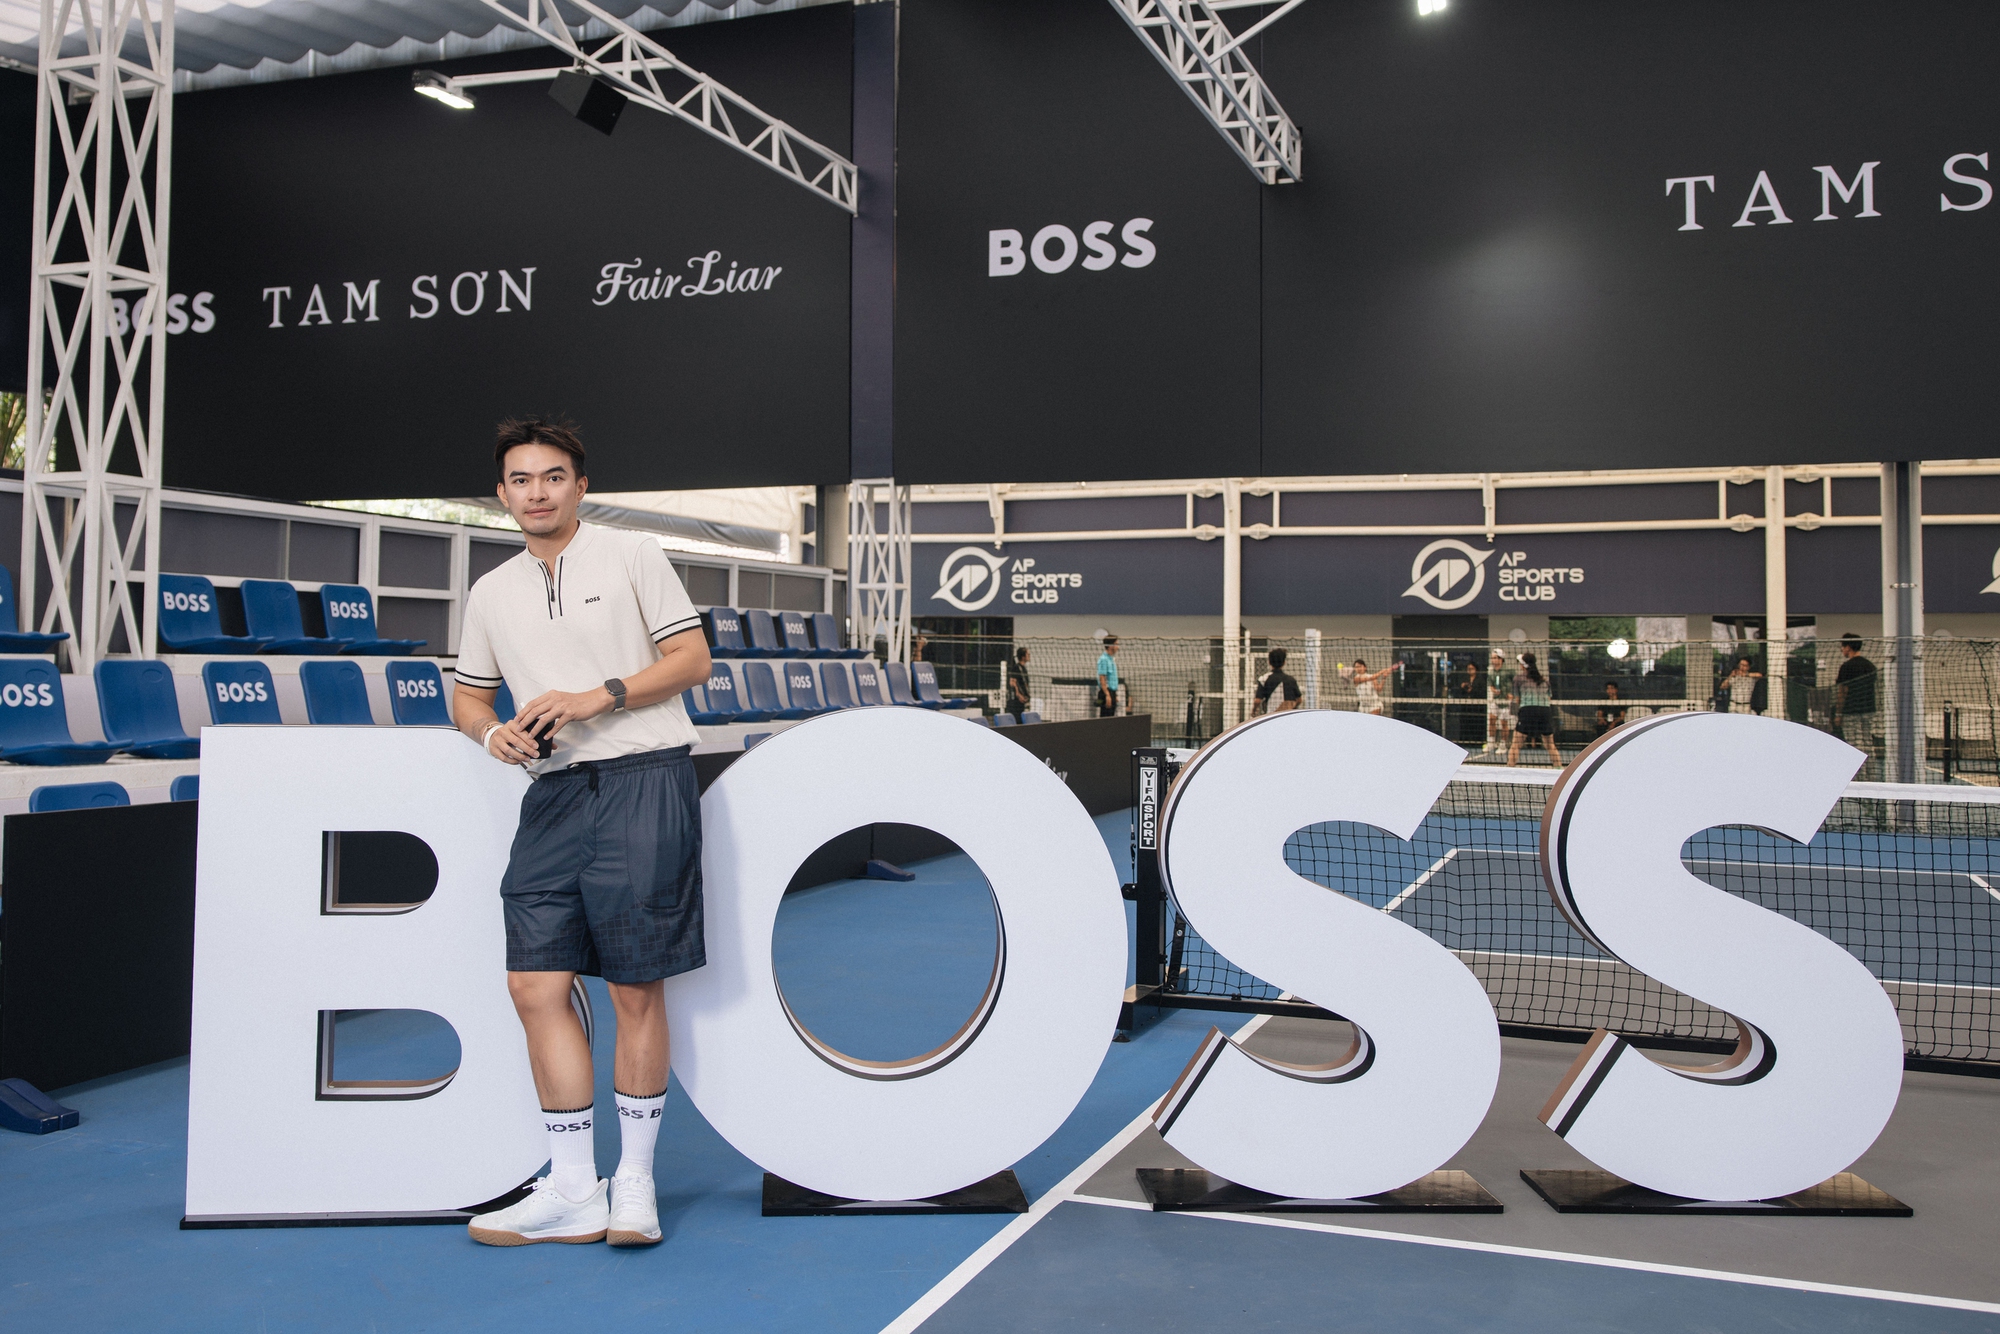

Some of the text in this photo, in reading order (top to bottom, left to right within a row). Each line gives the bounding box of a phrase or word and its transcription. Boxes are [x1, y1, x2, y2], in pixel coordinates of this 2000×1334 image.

[1665, 161, 1882, 231] TAM
[988, 217, 1157, 278] BOSS
[262, 266, 538, 329] TAM SƠN
[1011, 558, 1036, 573] AP
[1498, 551, 1527, 567] AP
[1011, 573, 1083, 588] SPORTS
[1498, 568, 1585, 584] SPORTS
[162, 591, 211, 613] BOSS
[585, 596, 601, 604] BOSS
[1011, 589, 1059, 604] CLUB
[1498, 585, 1556, 602] CLUB
[330, 601, 368, 620] BOSS
[716, 619, 739, 632] BOSS
[785, 623, 805, 635] BOSS
[397, 679, 438, 698] BOSS
[790, 675, 812, 689] BOSS
[0, 683, 54, 708] OSS
[216, 682, 268, 703] BOSS
[186, 706, 1903, 1216] BOSS
